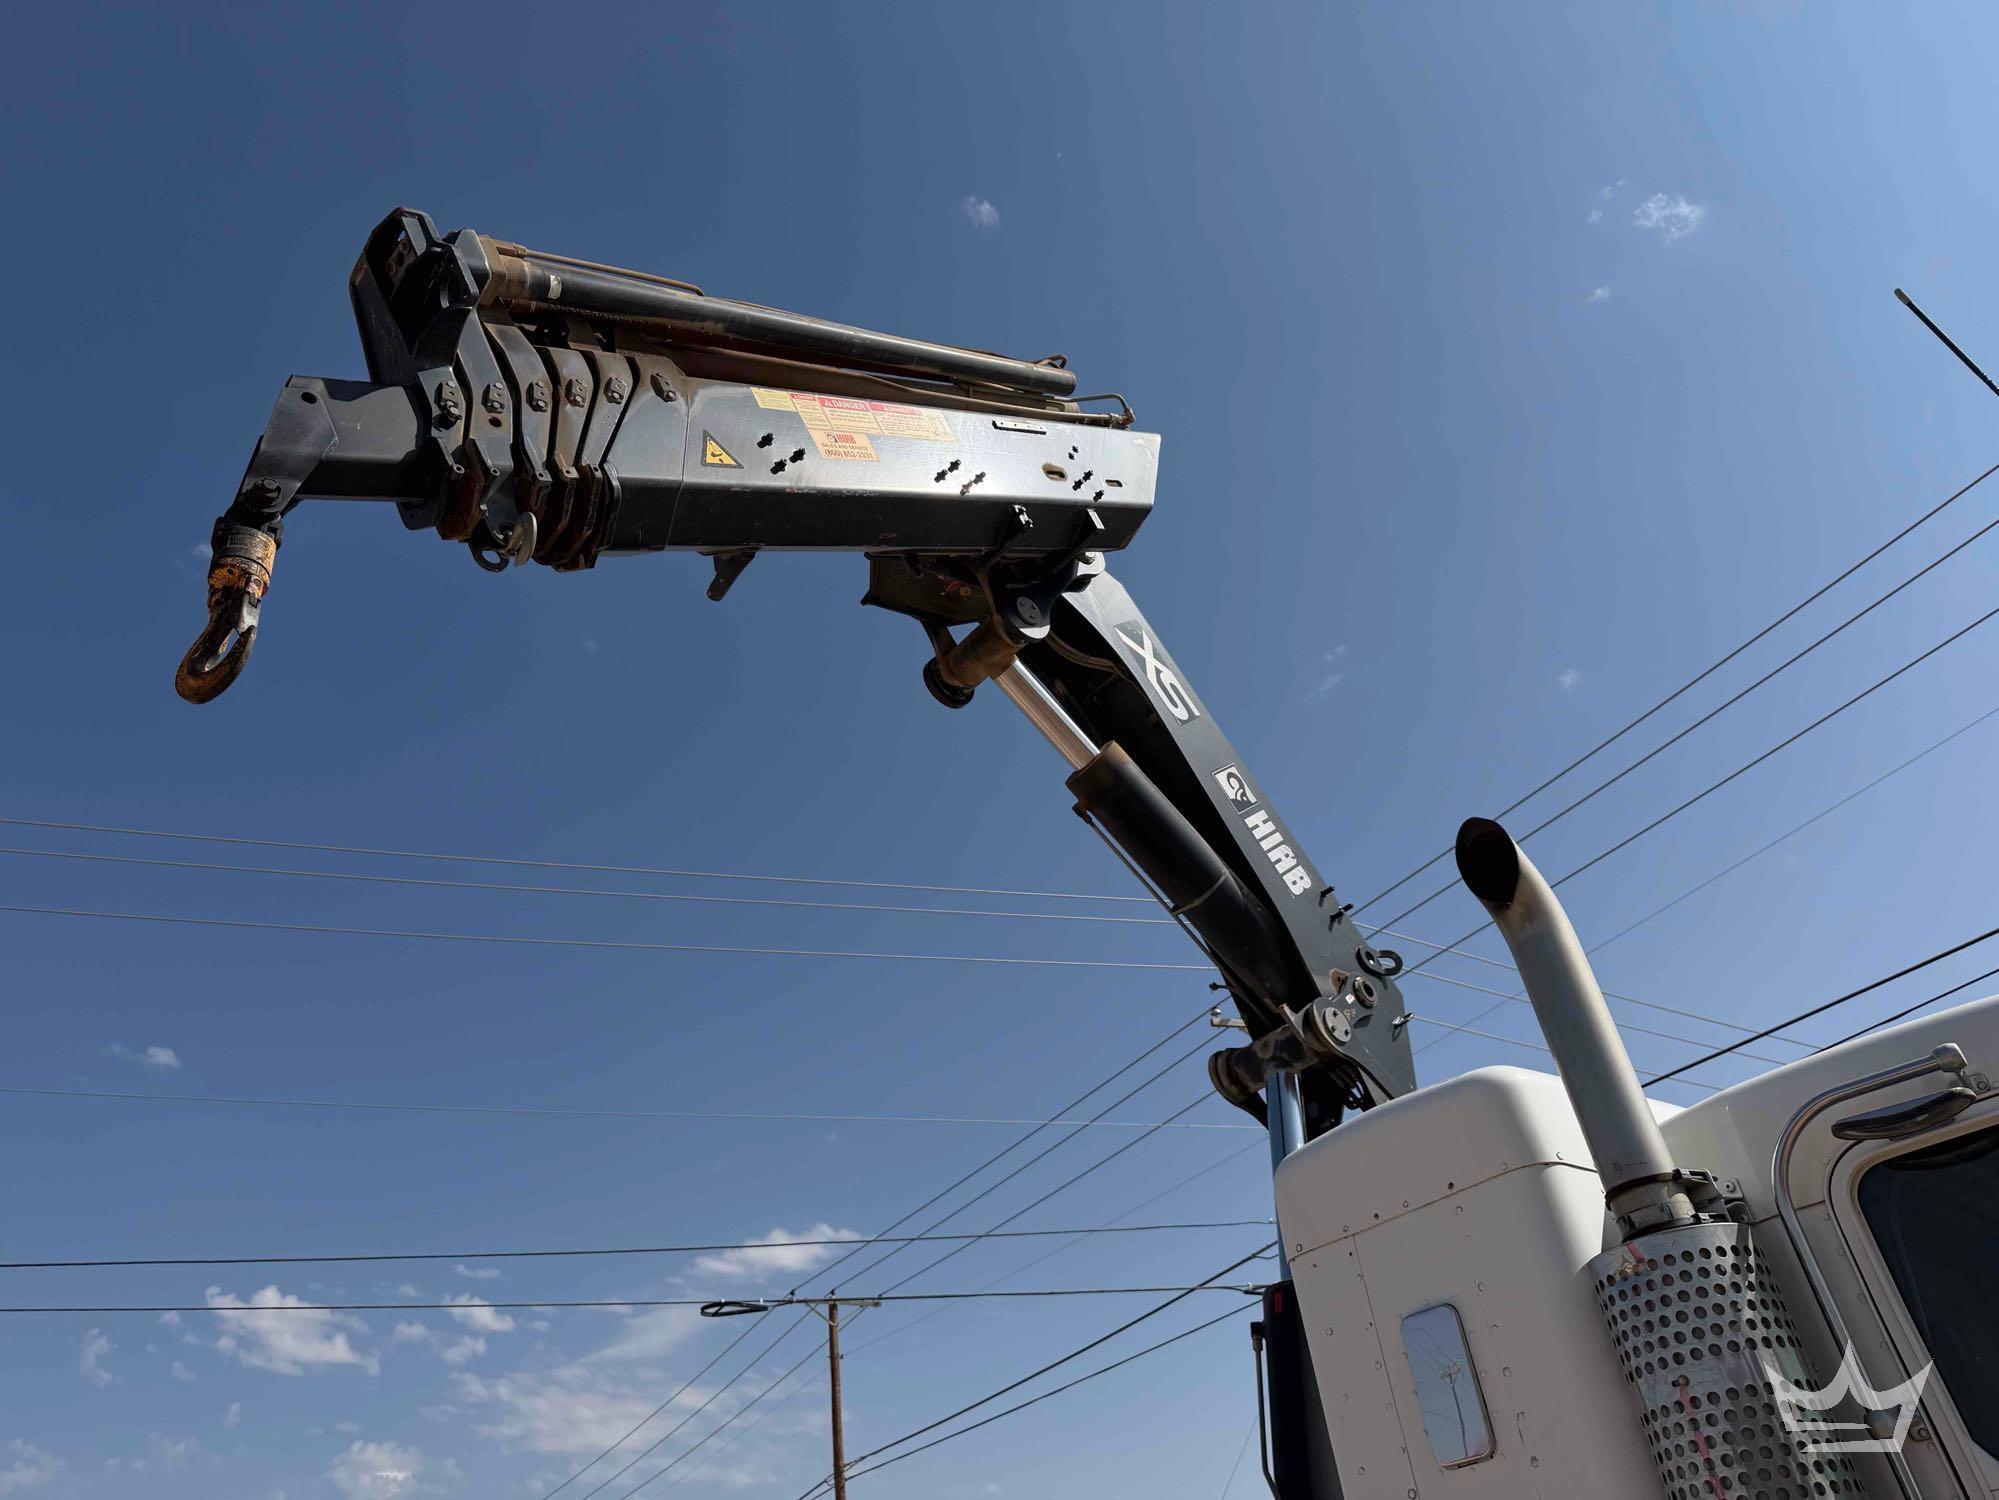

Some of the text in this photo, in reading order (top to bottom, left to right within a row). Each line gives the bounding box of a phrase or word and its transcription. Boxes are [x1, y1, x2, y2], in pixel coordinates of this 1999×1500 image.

[831, 399, 867, 411] DANGER
[1114, 626, 1201, 721] XS
[1244, 809, 1312, 896] HIAB
